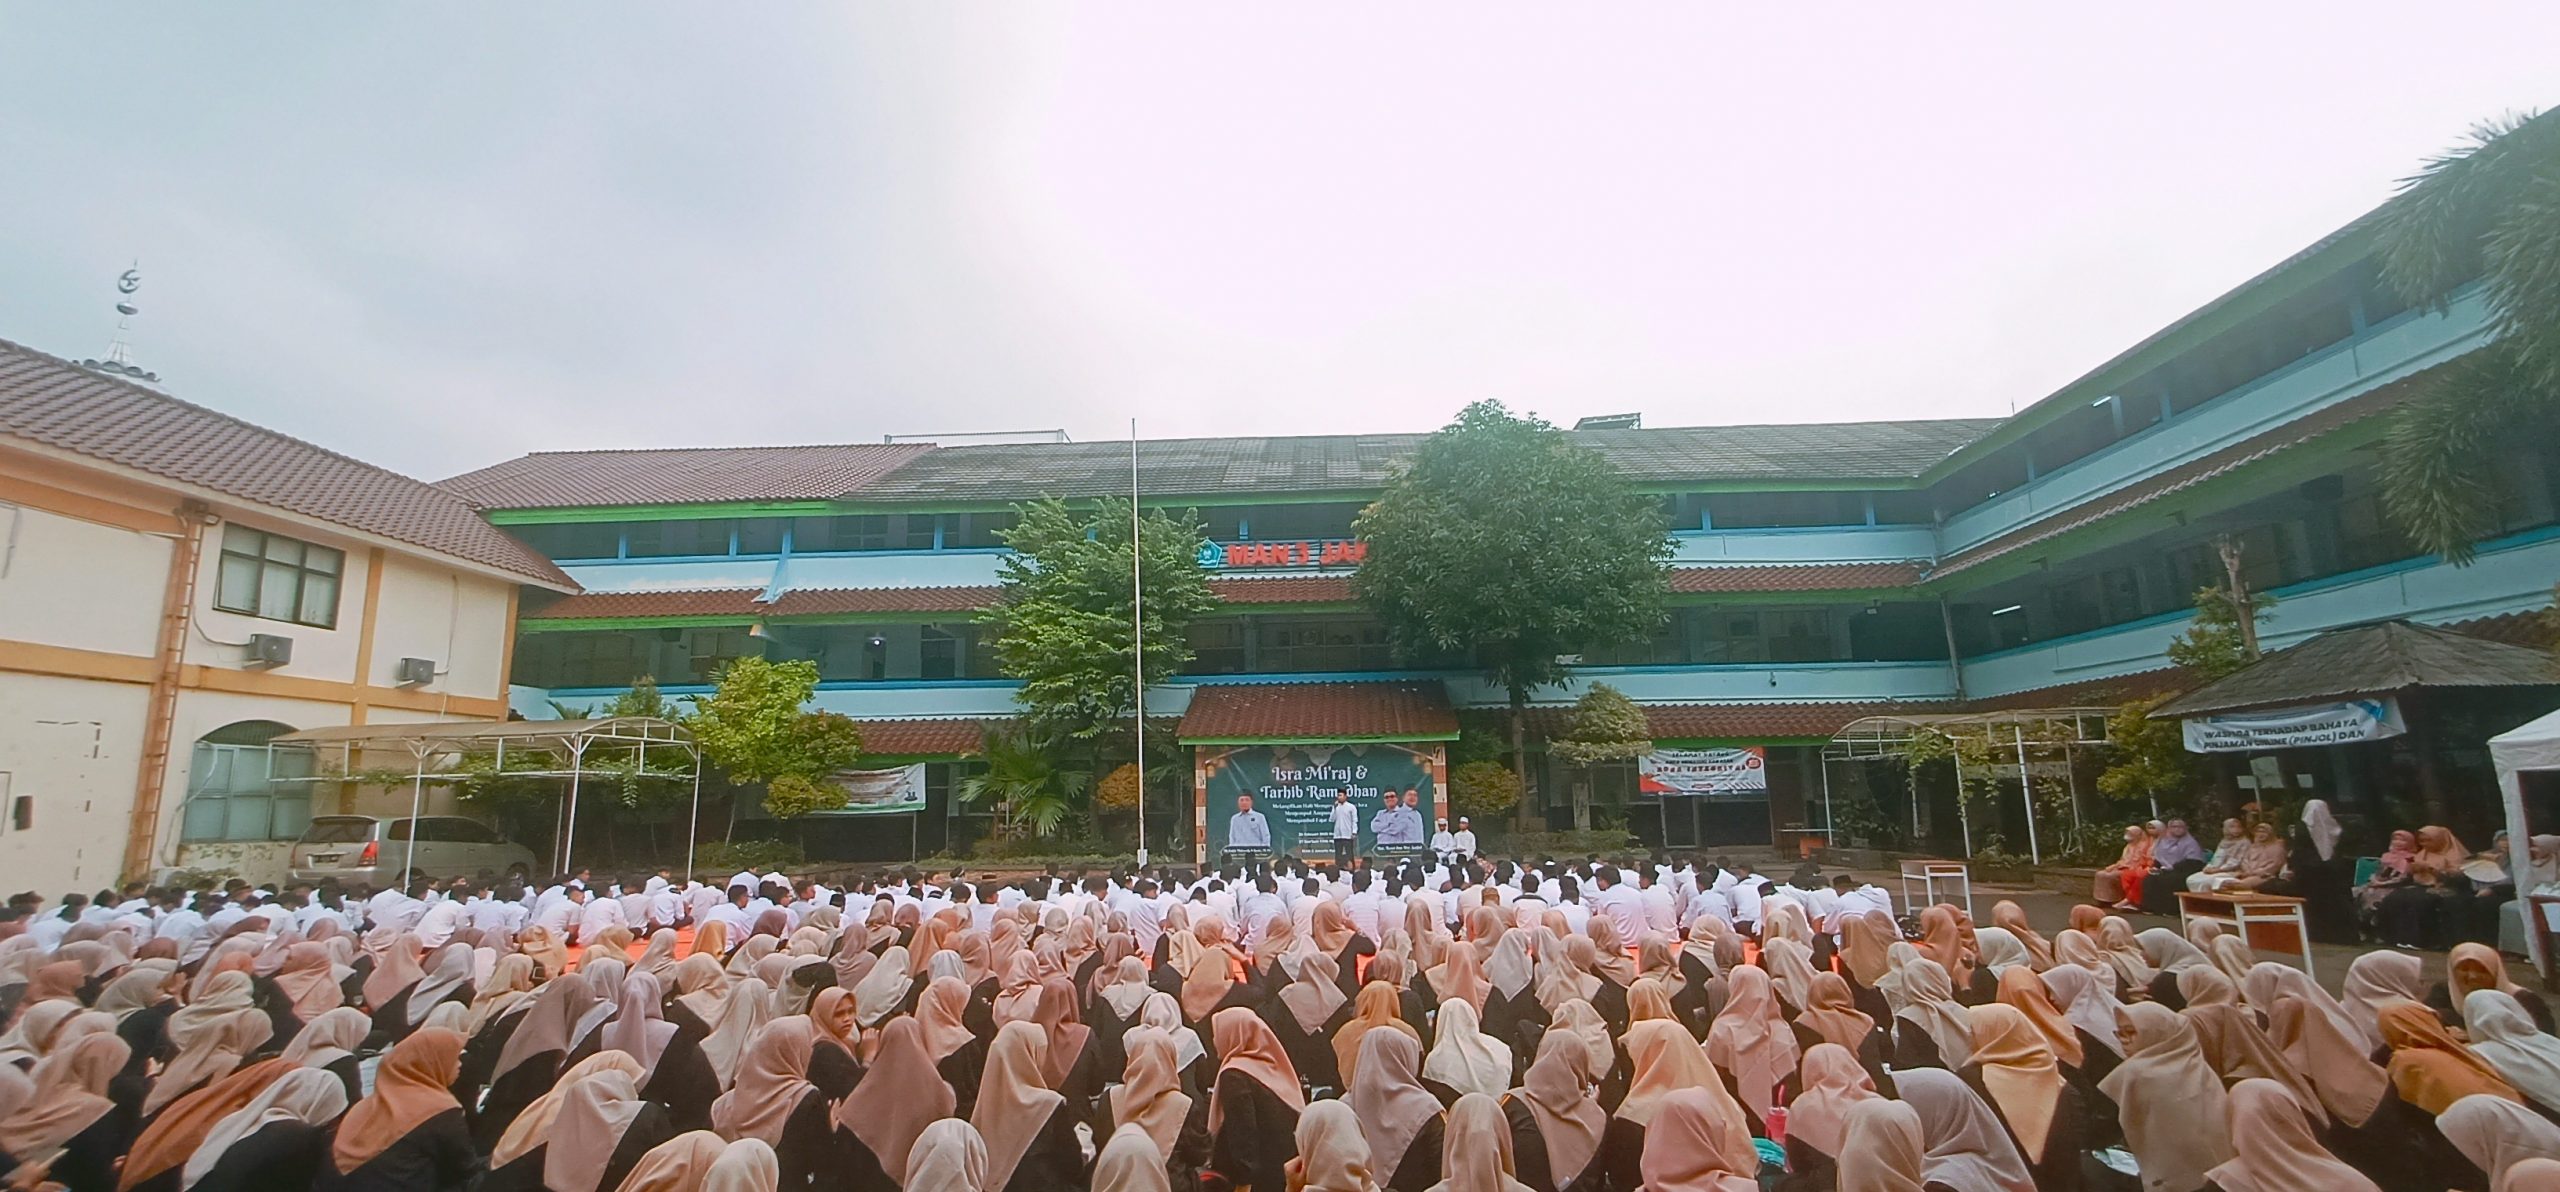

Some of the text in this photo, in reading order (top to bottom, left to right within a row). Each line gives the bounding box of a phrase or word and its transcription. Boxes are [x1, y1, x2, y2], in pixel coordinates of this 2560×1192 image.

[1227, 543, 1290, 566] MAN
[1294, 541, 1310, 565] 3
[2252, 723, 2308, 736] TERHADAP
[2309, 718, 2359, 732] BAHAYA
[2203, 739, 2253, 750] PINJAMAN
[2289, 731, 2336, 746] (PINJOL)
[2338, 729, 2366, 740] DAN
[1271, 764, 1368, 784] Isra Mi'raj &
[1260, 784, 1378, 800] Tarhib Ramdhan
